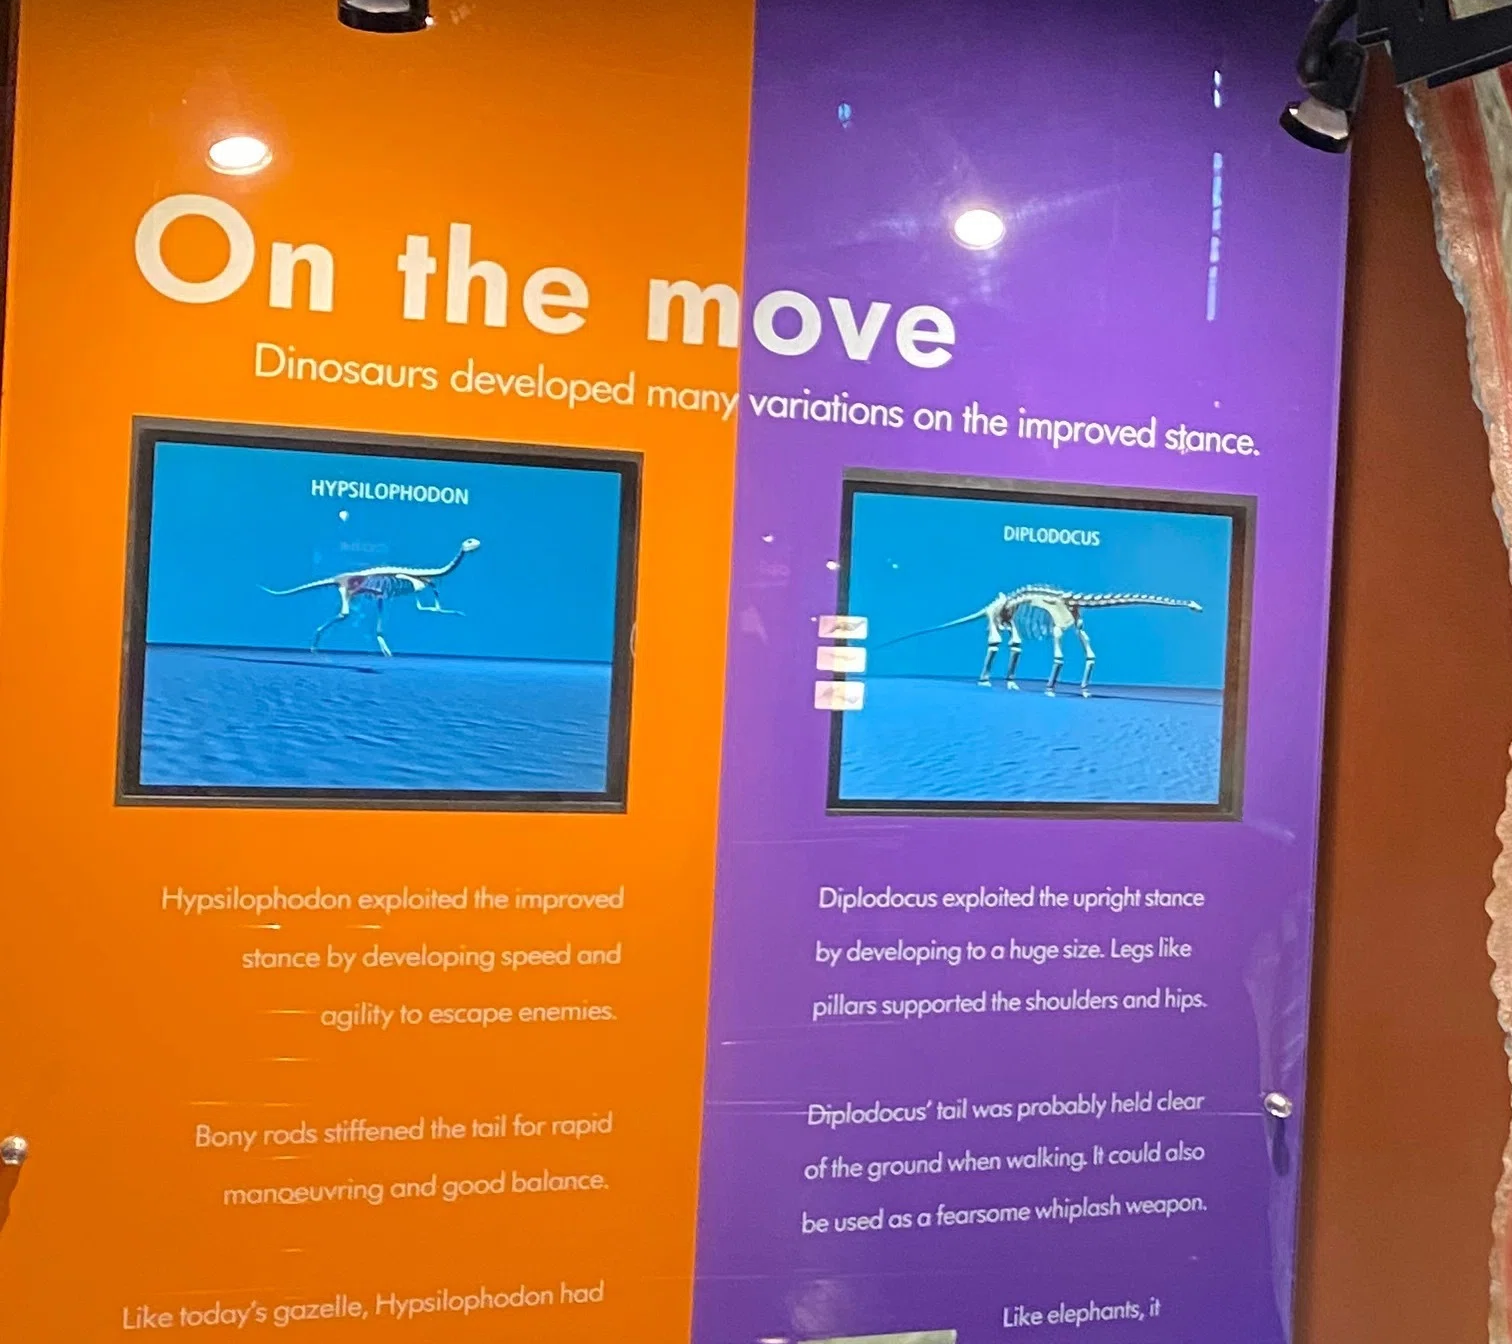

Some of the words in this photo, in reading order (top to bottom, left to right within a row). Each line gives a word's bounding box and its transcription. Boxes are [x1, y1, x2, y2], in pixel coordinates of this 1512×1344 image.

[134, 193, 335, 313] On
[397, 222, 590, 335] the
[647, 278, 956, 369] move
[254, 341, 439, 391] Dinosaurs
[449, 357, 636, 410] developed
[647, 385, 741, 423] many
[748, 387, 905, 429] variations
[912, 407, 953, 432] on
[961, 400, 1009, 437] the
[1017, 406, 1158, 450] improved
[1164, 423, 1261, 457] stance.
[311, 479, 469, 505] HYPSILOPHODON
[1003, 525, 1101, 547] DIPLODOCUS
[161, 885, 353, 916] Hypsilophodon
[357, 885, 469, 915] exploited
[473, 885, 510, 910] the
[515, 885, 625, 914] improved
[818, 885, 939, 914] Diplodocus
[941, 885, 1036, 913] exploited
[1038, 885, 1070, 908] the
[1072, 885, 1143, 913] upright
[1144, 888, 1206, 908] stance
[241, 948, 321, 969] stance
[326, 943, 357, 973] by
[361, 943, 496, 973] developing
[500, 943, 572, 971] speed
[576, 942, 623, 966] and
[815, 939, 844, 968] by
[845, 938, 963, 967] developing
[965, 941, 988, 961] to
[990, 944, 1006, 960] a
[1009, 937, 1060, 966] huge
[1062, 938, 1106, 960] size.
[1110, 937, 1155, 964] Legs
[1158, 936, 1193, 958] like
[320, 1001, 395, 1032] agility
[399, 1004, 424, 1025] to
[428, 1007, 514, 1028] escape
[517, 1000, 617, 1023] enemies.
[812, 992, 878, 1022] pillars
[881, 990, 988, 1020] supported
[990, 989, 1023, 1012] the
[1025, 988, 1120, 1012] shoulders
[1121, 986, 1161, 1010] and
[1164, 986, 1208, 1014] hips.
[936, 1097, 968, 1121] tail
[971, 1102, 1014, 1119] was
[1016, 1092, 1108, 1123] probably
[1110, 1089, 1154, 1114] held
[1155, 1089, 1206, 1112] clear
[195, 1123, 258, 1153] Bony
[263, 1120, 319, 1145] rods
[323, 1116, 426, 1144] stiffened
[430, 1116, 467, 1140] the
[471, 1114, 508, 1138] tail
[512, 1112, 547, 1137] for
[551, 1110, 614, 1140] rapid
[803, 1155, 829, 1181] of
[830, 1155, 864, 1179] the
[866, 1150, 945, 1183] ground
[946, 1149, 1002, 1172] when
[1005, 1145, 1089, 1173] walking.
[1092, 1144, 1105, 1166] It
[1107, 1140, 1162, 1165] could
[1164, 1139, 1206, 1163] also
[223, 1179, 385, 1206] manoeuvring
[389, 1173, 438, 1199] and
[441, 1170, 507, 1203] good
[510, 1168, 609, 1194] balance.
[801, 1211, 830, 1235] be
[833, 1207, 885, 1233] used
[887, 1212, 914, 1229] as
[916, 1211, 933, 1228] a
[935, 1203, 1032, 1227] fearsome
[1034, 1194, 1122, 1224] whiplash
[1124, 1196, 1208, 1218] weapon.
[122, 1304, 174, 1330] Like
[273, 1293, 369, 1328] gazelle,
[375, 1284, 555, 1320] Hypsilophodon
[559, 1279, 605, 1304] had
[1002, 1304, 1044, 1328] Like
[1046, 1299, 1146, 1328] elephants,
[1149, 1296, 1162, 1317] it
